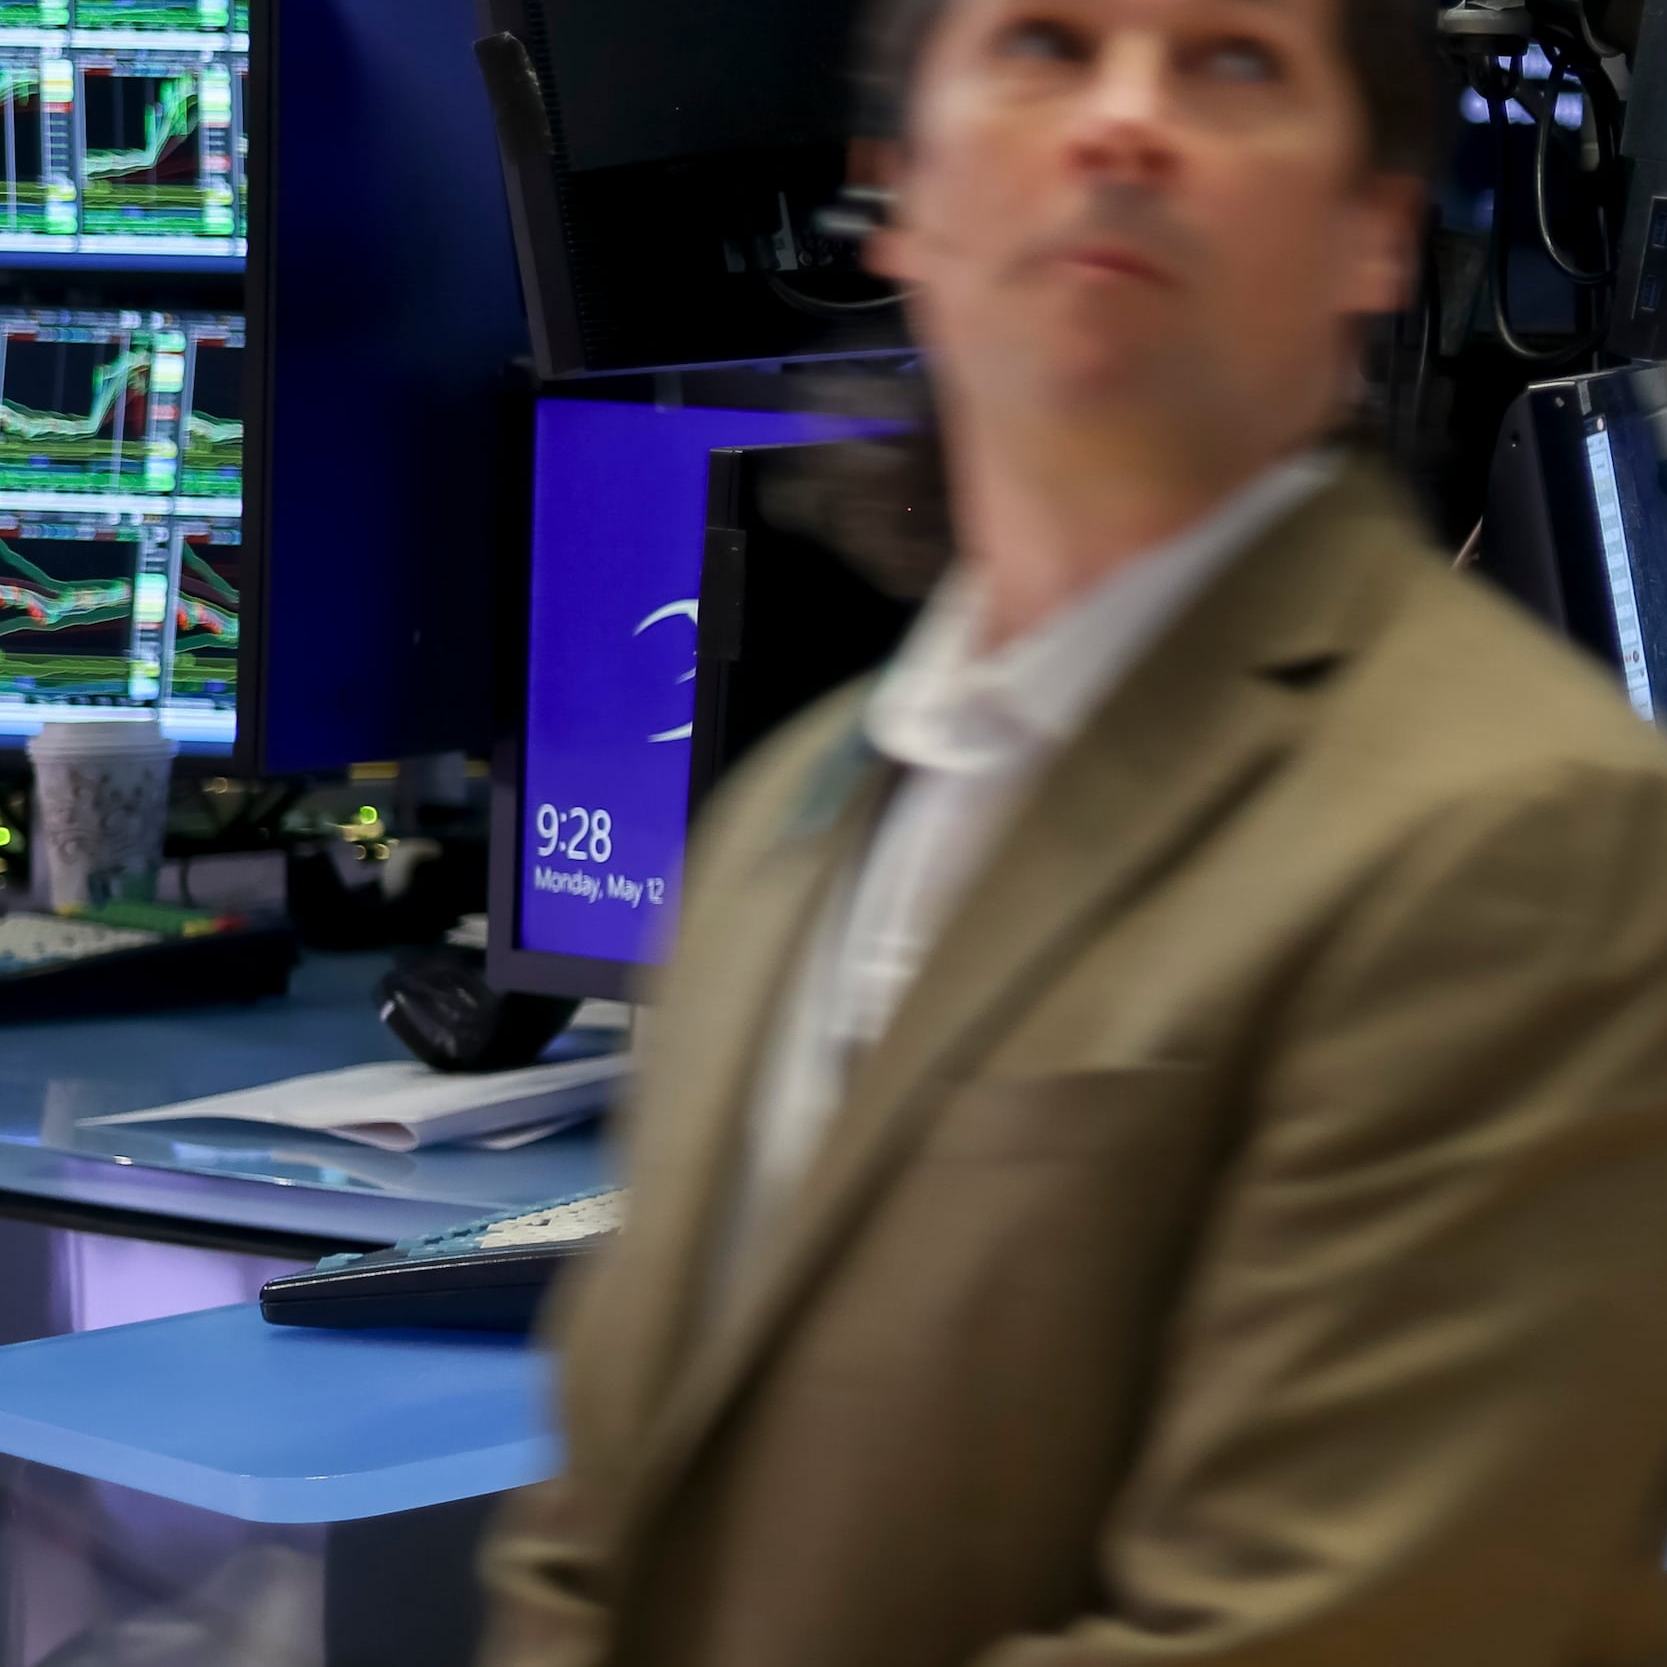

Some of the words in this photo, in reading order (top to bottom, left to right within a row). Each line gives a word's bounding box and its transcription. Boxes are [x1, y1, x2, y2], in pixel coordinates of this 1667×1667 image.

[537, 803, 612, 863] 9:28
[534, 866, 604, 904] Monday,
[607, 874, 643, 908] May
[647, 877, 665, 905] 12
